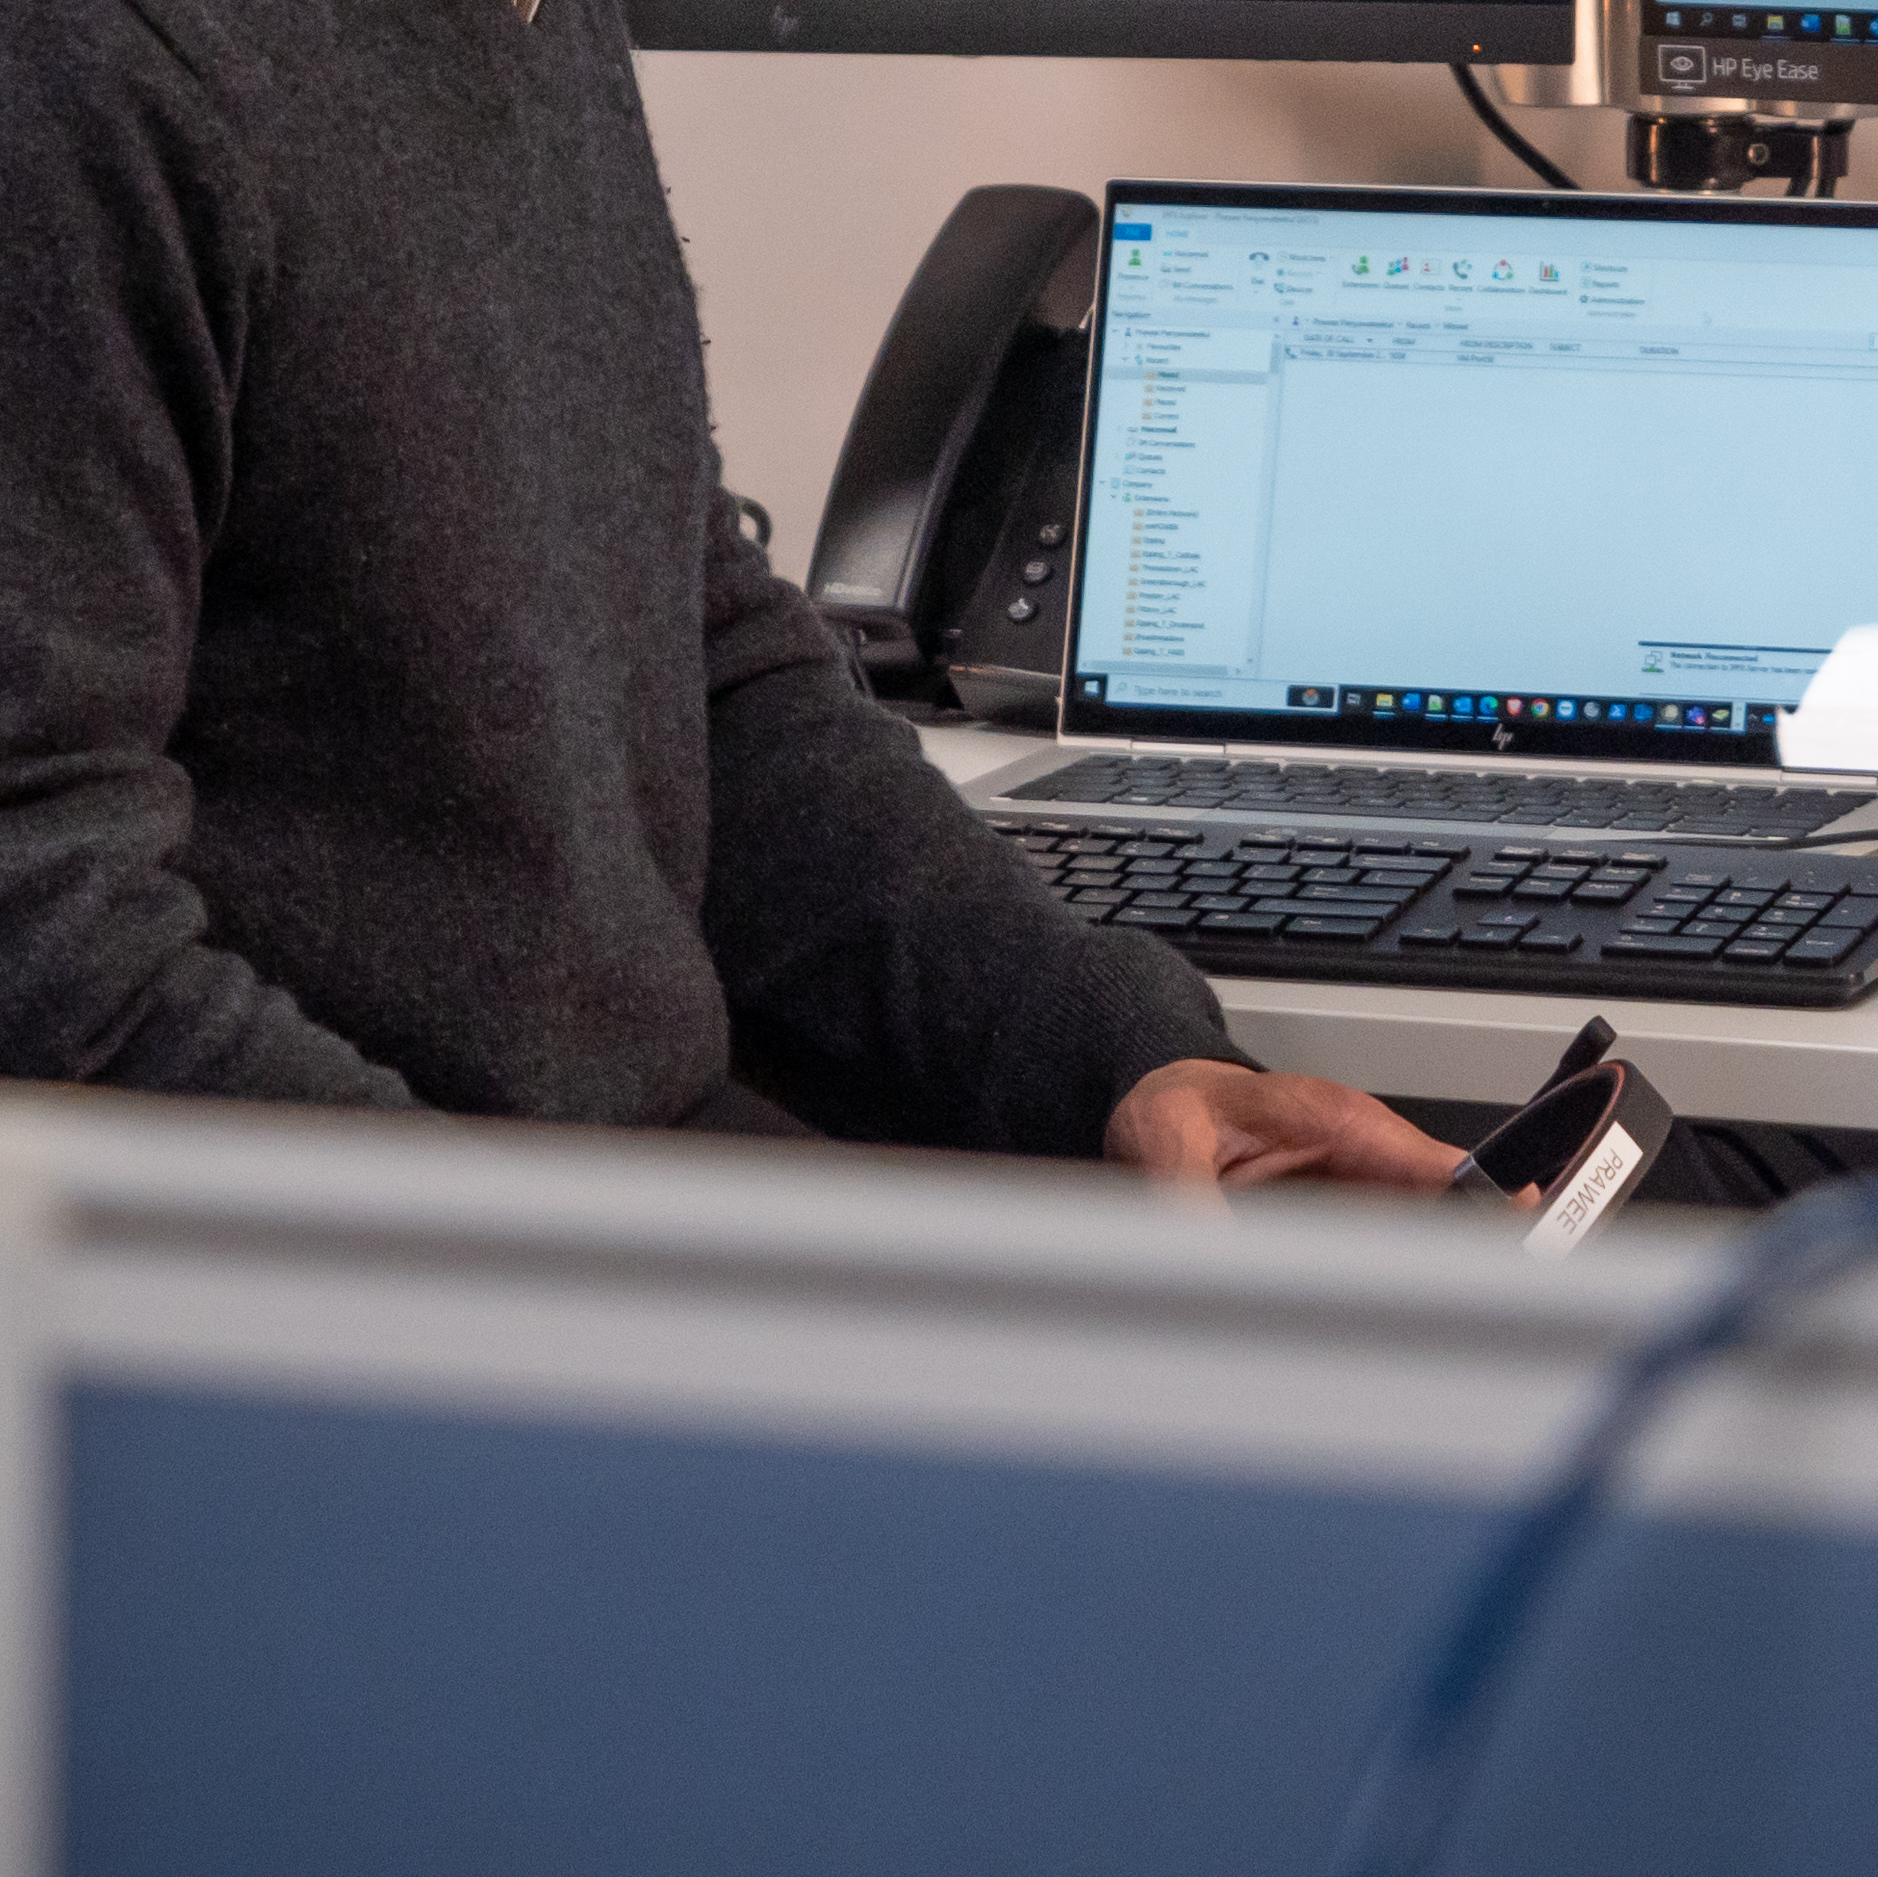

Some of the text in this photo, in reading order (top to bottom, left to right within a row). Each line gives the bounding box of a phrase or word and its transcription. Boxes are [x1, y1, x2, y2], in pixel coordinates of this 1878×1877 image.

[1713, 57, 1819, 82] HP Eye Ease
